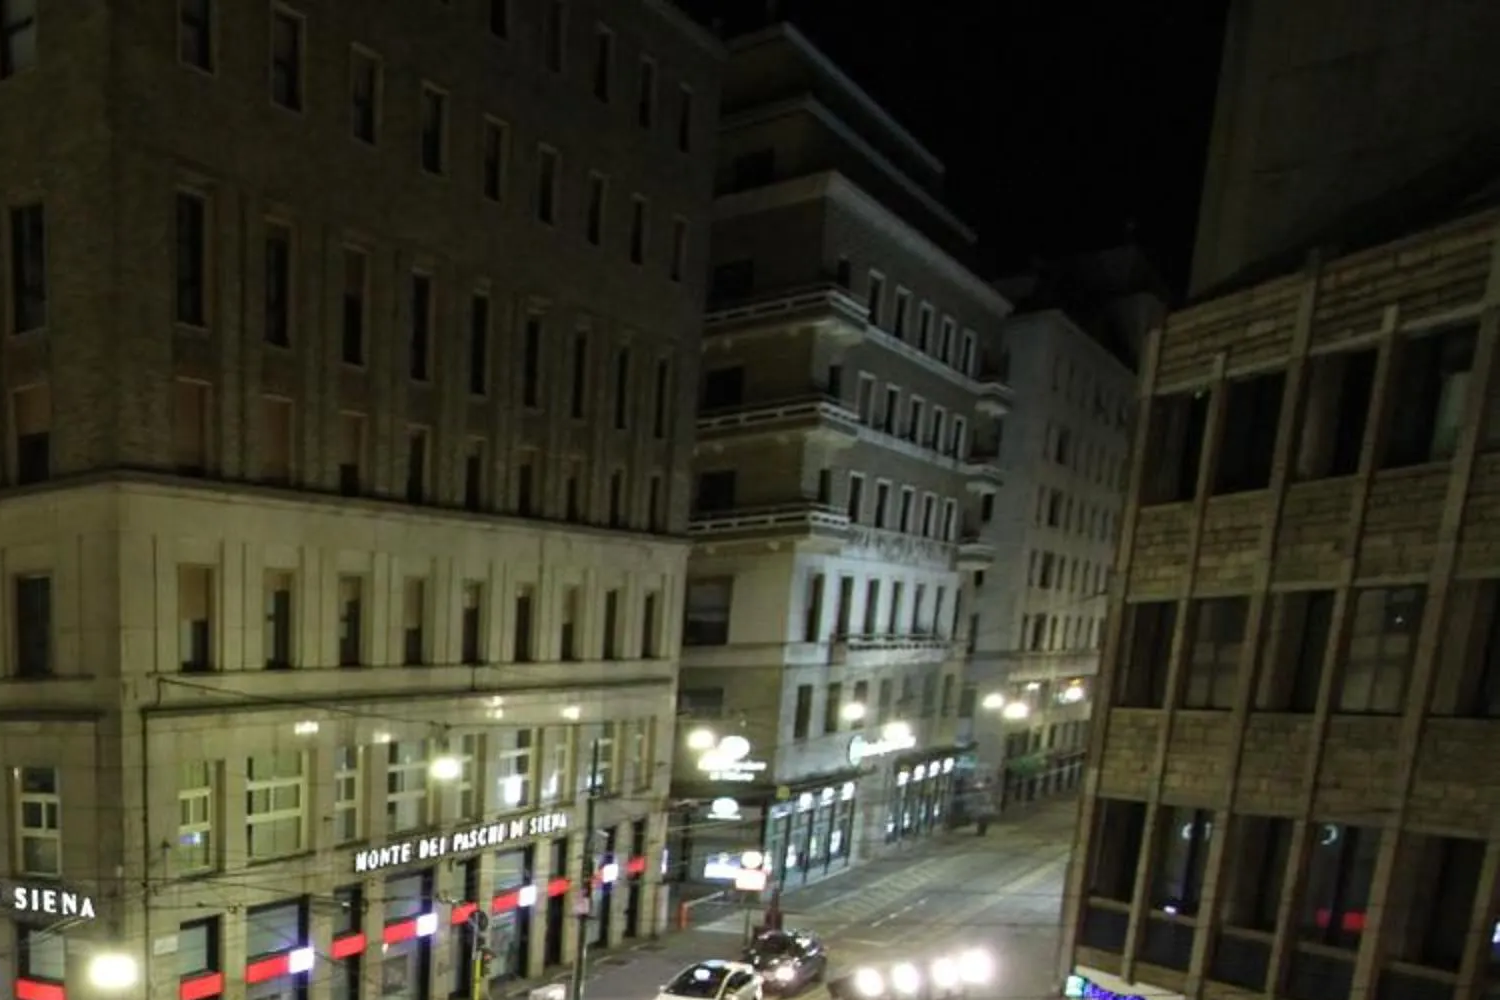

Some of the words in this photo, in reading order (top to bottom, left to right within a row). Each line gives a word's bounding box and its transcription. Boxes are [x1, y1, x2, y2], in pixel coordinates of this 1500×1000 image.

[355, 843, 411, 872] MONTE
[419, 836, 445, 859] DEI
[453, 823, 505, 852] PASCHI
[14, 886, 95, 918] SIENA
